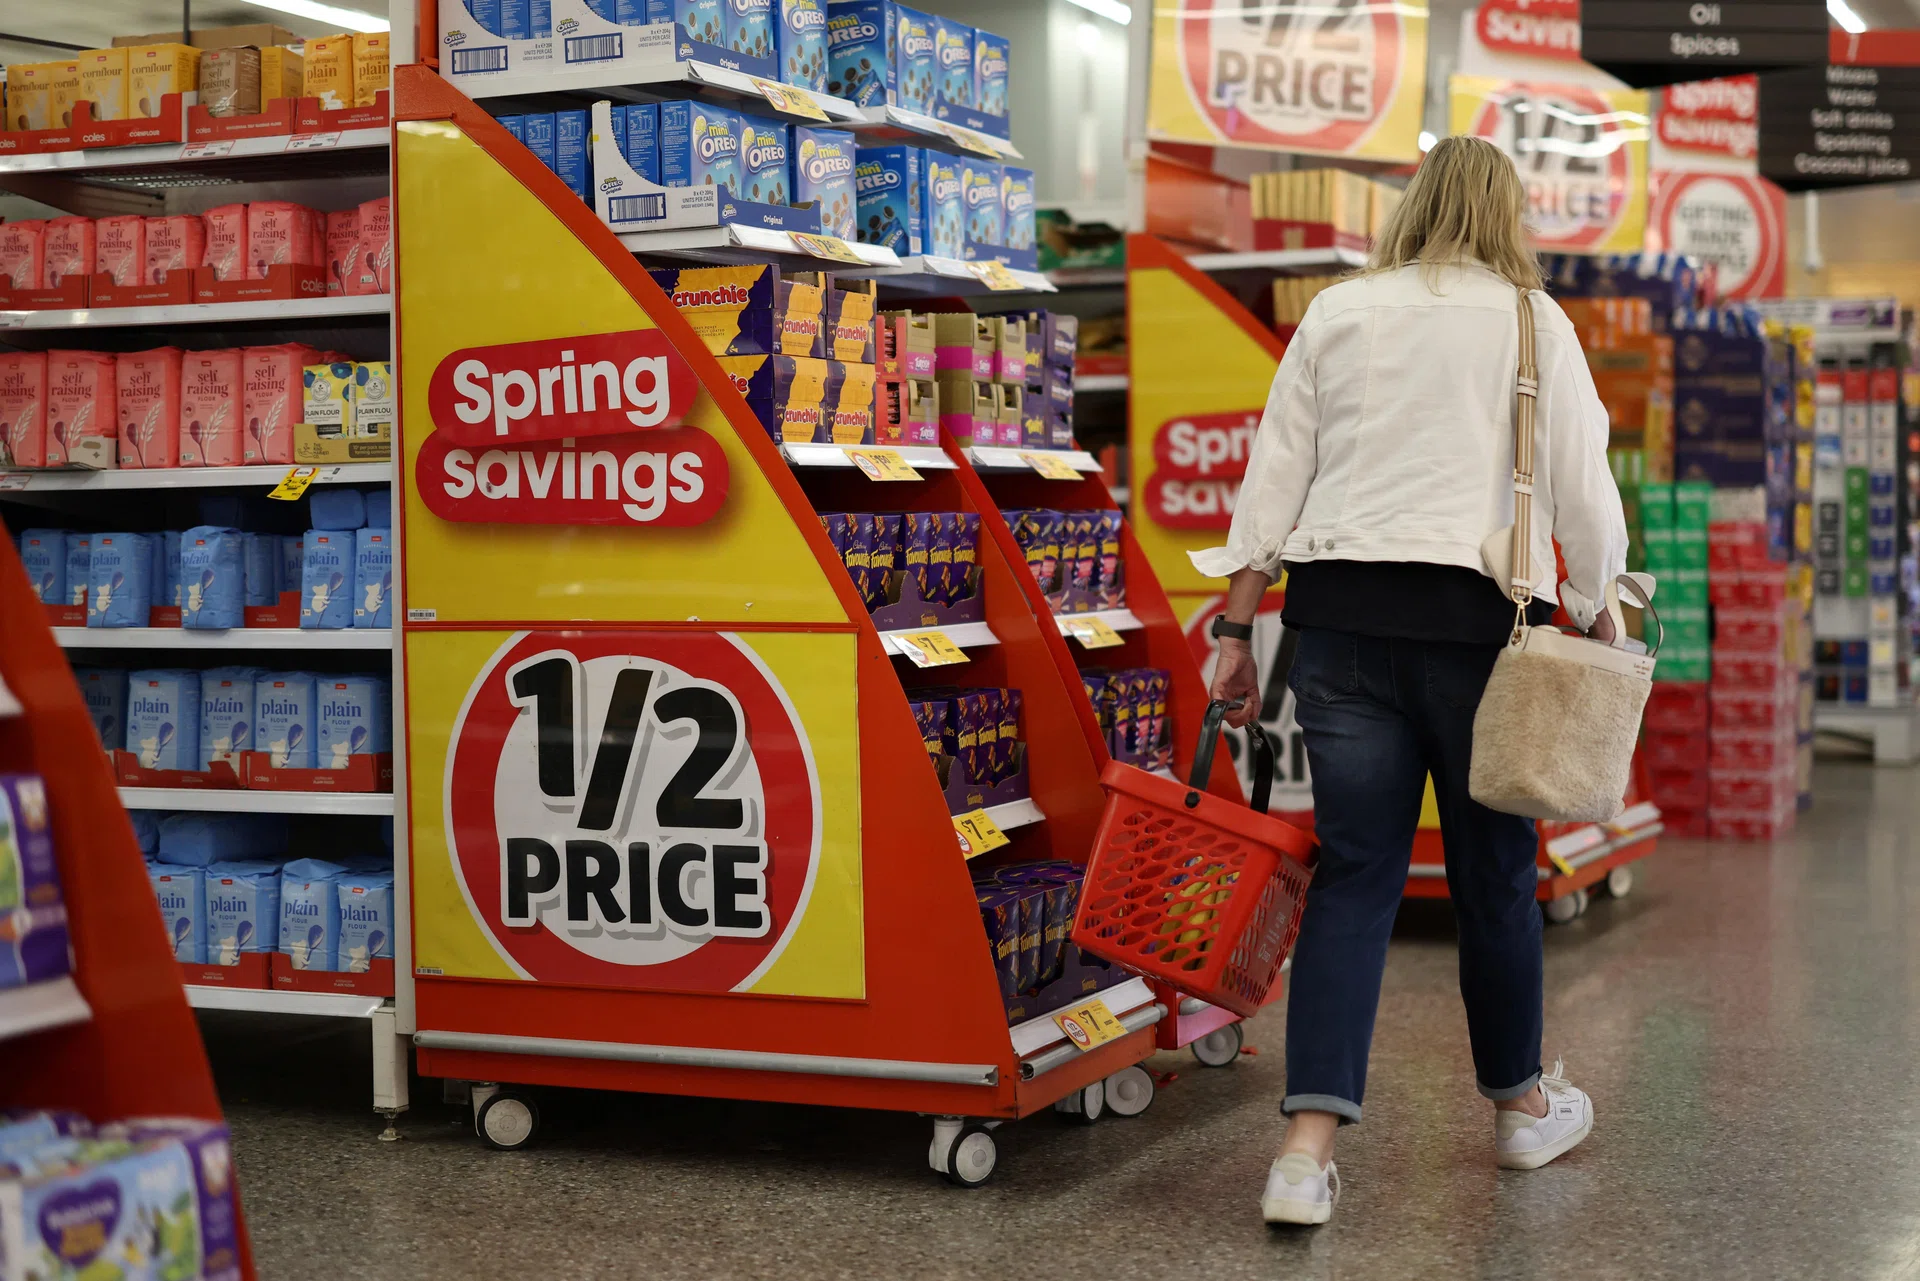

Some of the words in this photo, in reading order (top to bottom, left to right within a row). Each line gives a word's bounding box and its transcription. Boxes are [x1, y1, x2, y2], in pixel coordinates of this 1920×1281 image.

[700, 1, 716, 9] Original
[750, 14, 766, 24] Original
[792, 9, 824, 29] OREO
[1690, 4, 1721, 26] Oil
[556, 20, 580, 33] OREO
[444, 32, 467, 44] OREO
[1670, 33, 1739, 56] Spices
[680, 48, 694, 56] OREO
[906, 38, 933, 55] OREO
[306, 56, 338, 64] wholemeal
[942, 47, 970, 64] OREO
[132, 62, 172, 75] cornflour
[720, 58, 740, 70] Original
[82, 67, 122, 78] cornflour
[208, 68, 222, 79] self
[306, 65, 338, 82] plain
[1826, 65, 1878, 86] Mixers
[10, 82, 50, 92] cornflour
[202, 78, 230, 91] raising
[1216, 50, 1369, 114] PRICE
[1827, 88, 1877, 106] Water
[1811, 108, 1844, 128] Soft
[1846, 110, 1894, 130] drinks
[82, 132, 106, 142] coles
[129, 130, 160, 138] CORNFLOUR
[708, 125, 728, 136] mini
[1500, 96, 1599, 174] 1/2
[702, 136, 736, 158] OREO
[756, 136, 776, 147] mini
[750, 148, 785, 168] OREO
[818, 146, 840, 158] mini
[716, 159, 732, 170] Original
[809, 157, 852, 178] OREO
[1794, 153, 1866, 174] Coconut
[1868, 155, 1910, 178] juice
[762, 168, 780, 180] Original
[600, 179, 624, 192] OREO
[826, 179, 846, 190] Original
[936, 180, 960, 200] OREO
[968, 186, 998, 205] OREO
[1524, 183, 1610, 218] RICE
[722, 208, 736, 218] OREO
[764, 215, 784, 226] Original
[262, 218, 277, 228] self
[106, 228, 124, 239] self
[154, 227, 172, 238] self
[252, 228, 286, 240] raising
[328, 229, 360, 240] raising
[48, 240, 78, 252] raising
[100, 238, 132, 250] raising
[148, 236, 180, 249] raising
[672, 284, 748, 308] crunchie
[784, 320, 817, 336] crunchie
[837, 326, 868, 341] crunchie
[4, 372, 25, 385] self
[62, 372, 84, 384] self
[130, 372, 152, 385] self
[198, 370, 218, 382] self
[255, 365, 276, 380] self
[52, 384, 92, 399] raising
[120, 384, 161, 398] raising
[187, 382, 228, 398] raising
[246, 378, 286, 392] raising
[452, 349, 671, 436] Spring
[786, 408, 818, 424] crunchie
[834, 412, 868, 426] crunchie
[1168, 418, 1258, 473] Spri
[443, 437, 704, 522] savings
[853, 540, 867, 550] Cadbury
[879, 541, 892, 551] Cadbury
[92, 553, 121, 566] plain
[308, 552, 340, 567] plain
[360, 552, 392, 565] plain
[846, 548, 870, 568] Favourites
[871, 549, 894, 569] Favourites
[906, 546, 928, 566] Favourites
[930, 546, 952, 566] Favourites
[954, 544, 976, 564] Favourites
[133, 697, 170, 716] plain
[204, 698, 244, 716] plain
[261, 699, 298, 718] plain
[323, 700, 362, 720] plain
[978, 727, 997, 746] Favourites
[998, 720, 1018, 739] Favourites
[512, 656, 744, 831] 1/2
[958, 731, 978, 750] Favourites
[960, 818, 983, 840] $7
[506, 837, 763, 929] PRICE
[158, 893, 185, 910] lain
[210, 896, 248, 916] plain
[285, 898, 319, 919] plain
[340, 904, 378, 926] plain
[997, 934, 1019, 960] Favourites
[1020, 929, 1041, 953] Favourites
[278, 975, 292, 984] coles
[1078, 1009, 1100, 1031] $7
[1072, 1030, 1084, 1038] PRICE
